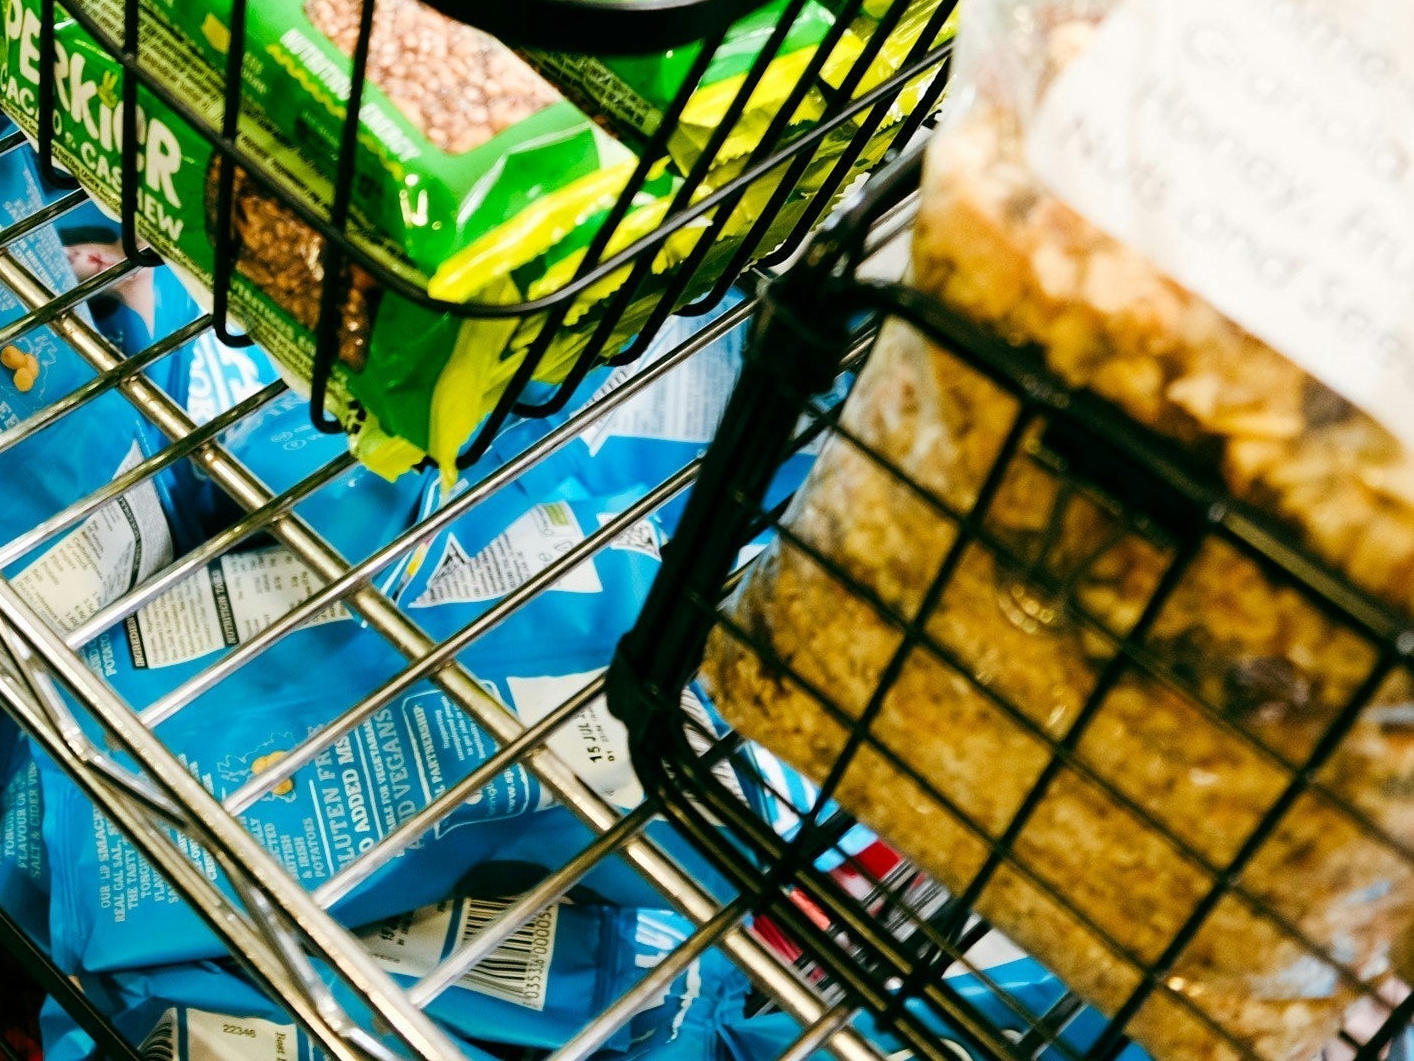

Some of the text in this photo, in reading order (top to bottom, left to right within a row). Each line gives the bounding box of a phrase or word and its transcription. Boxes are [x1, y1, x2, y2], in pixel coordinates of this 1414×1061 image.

[0, 63, 62, 135] CACO
[81, 142, 184, 241] CASEW
[123, 613, 147, 667] INGREDIEN
[373, 706, 412, 800] VEGANS
[578, 721, 603, 764] 15 JUL
[341, 767, 370, 833] ADDED
[378, 785, 391, 804] FOR
[99, 885, 113, 908] OUR
[122, 848, 140, 908] THE TASTY
[111, 893, 127, 922] REAL
[223, 1022, 257, 1040] 22348
